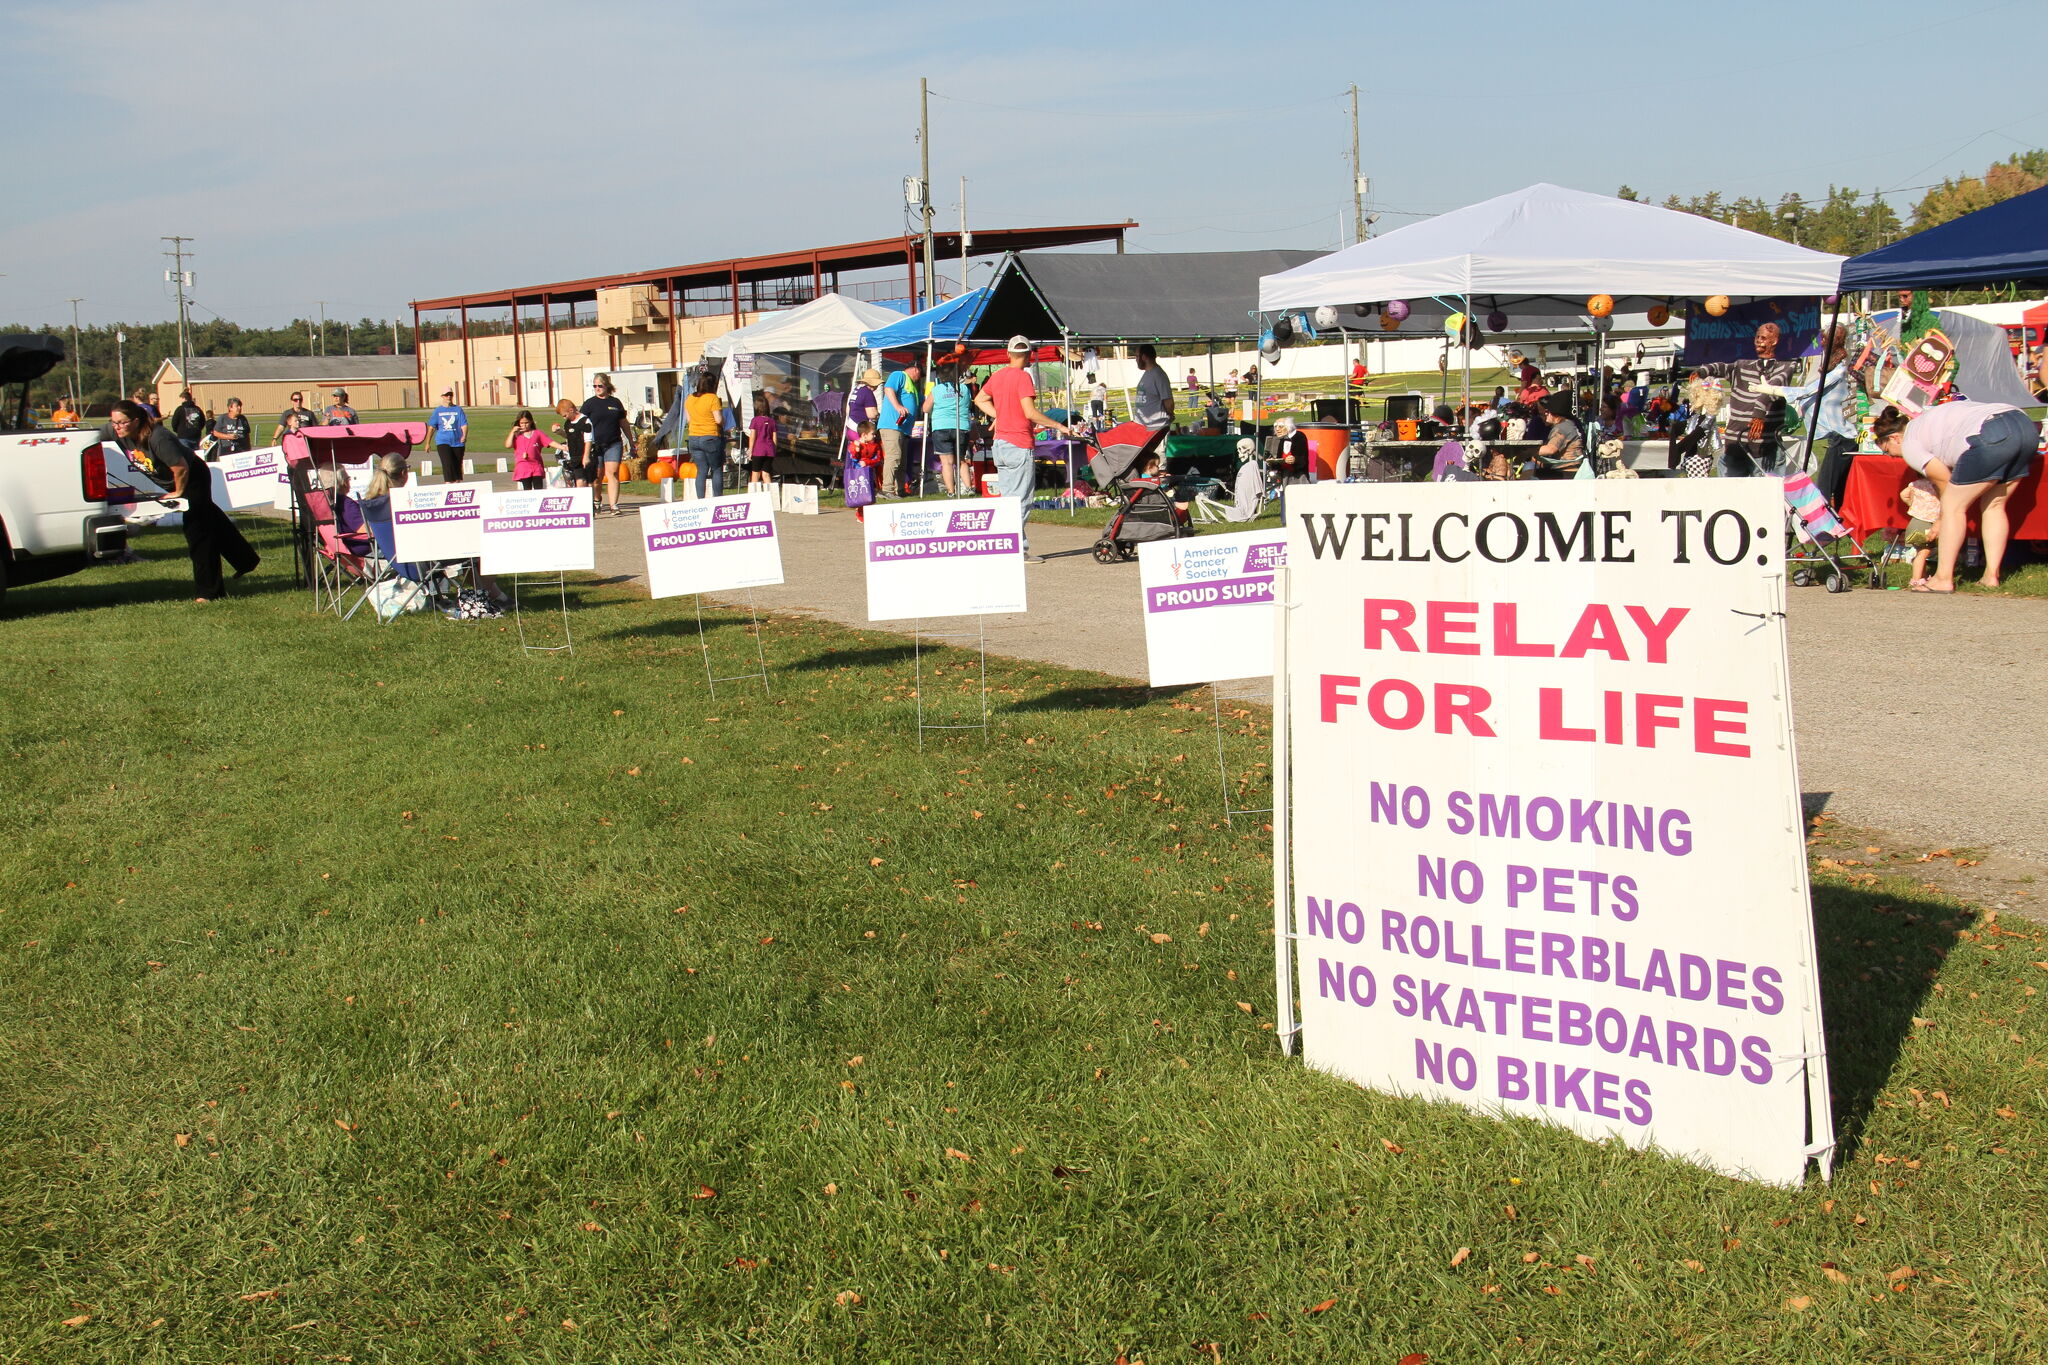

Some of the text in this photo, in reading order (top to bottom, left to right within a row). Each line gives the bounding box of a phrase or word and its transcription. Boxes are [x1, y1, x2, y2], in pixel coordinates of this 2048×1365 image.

[1690, 318, 1732, 339] Smells
[228, 471, 249, 480] PROUD
[671, 506, 708, 516] American
[721, 504, 748, 514] RELAY
[899, 510, 944, 520] American
[399, 512, 433, 522] PROUD
[671, 514, 701, 522] Cancer
[728, 511, 746, 520] LIFE
[959, 511, 991, 522] RELAY
[488, 516, 587, 531] PROUD SUPPORTER
[672, 521, 702, 530] Society
[899, 519, 934, 528] Cancer
[966, 520, 988, 530] LIFE
[653, 524, 769, 548] PROUD SUPPORTER
[900, 528, 936, 537] Society
[1300, 508, 1770, 567] WELCOME TO:
[876, 538, 1013, 558] PROUD SUPPORTER
[1184, 545, 1239, 559] American
[1184, 557, 1226, 569] Cancer
[1254, 558, 1268, 566] FOR
[1185, 568, 1229, 580] Society
[1156, 587, 1219, 607] PROUD
[1364, 599, 1690, 663] RELAY
[1320, 674, 1751, 757] FOR LIFE
[1370, 781, 1693, 856] NO SMOKING
[1418, 855, 1639, 922] NO PETS
[1307, 896, 1784, 1015] NO ROLLERBLADES
[1318, 958, 1773, 1085] NO SKATEBOARDS
[1415, 1038, 1653, 1126] NO BIKES
